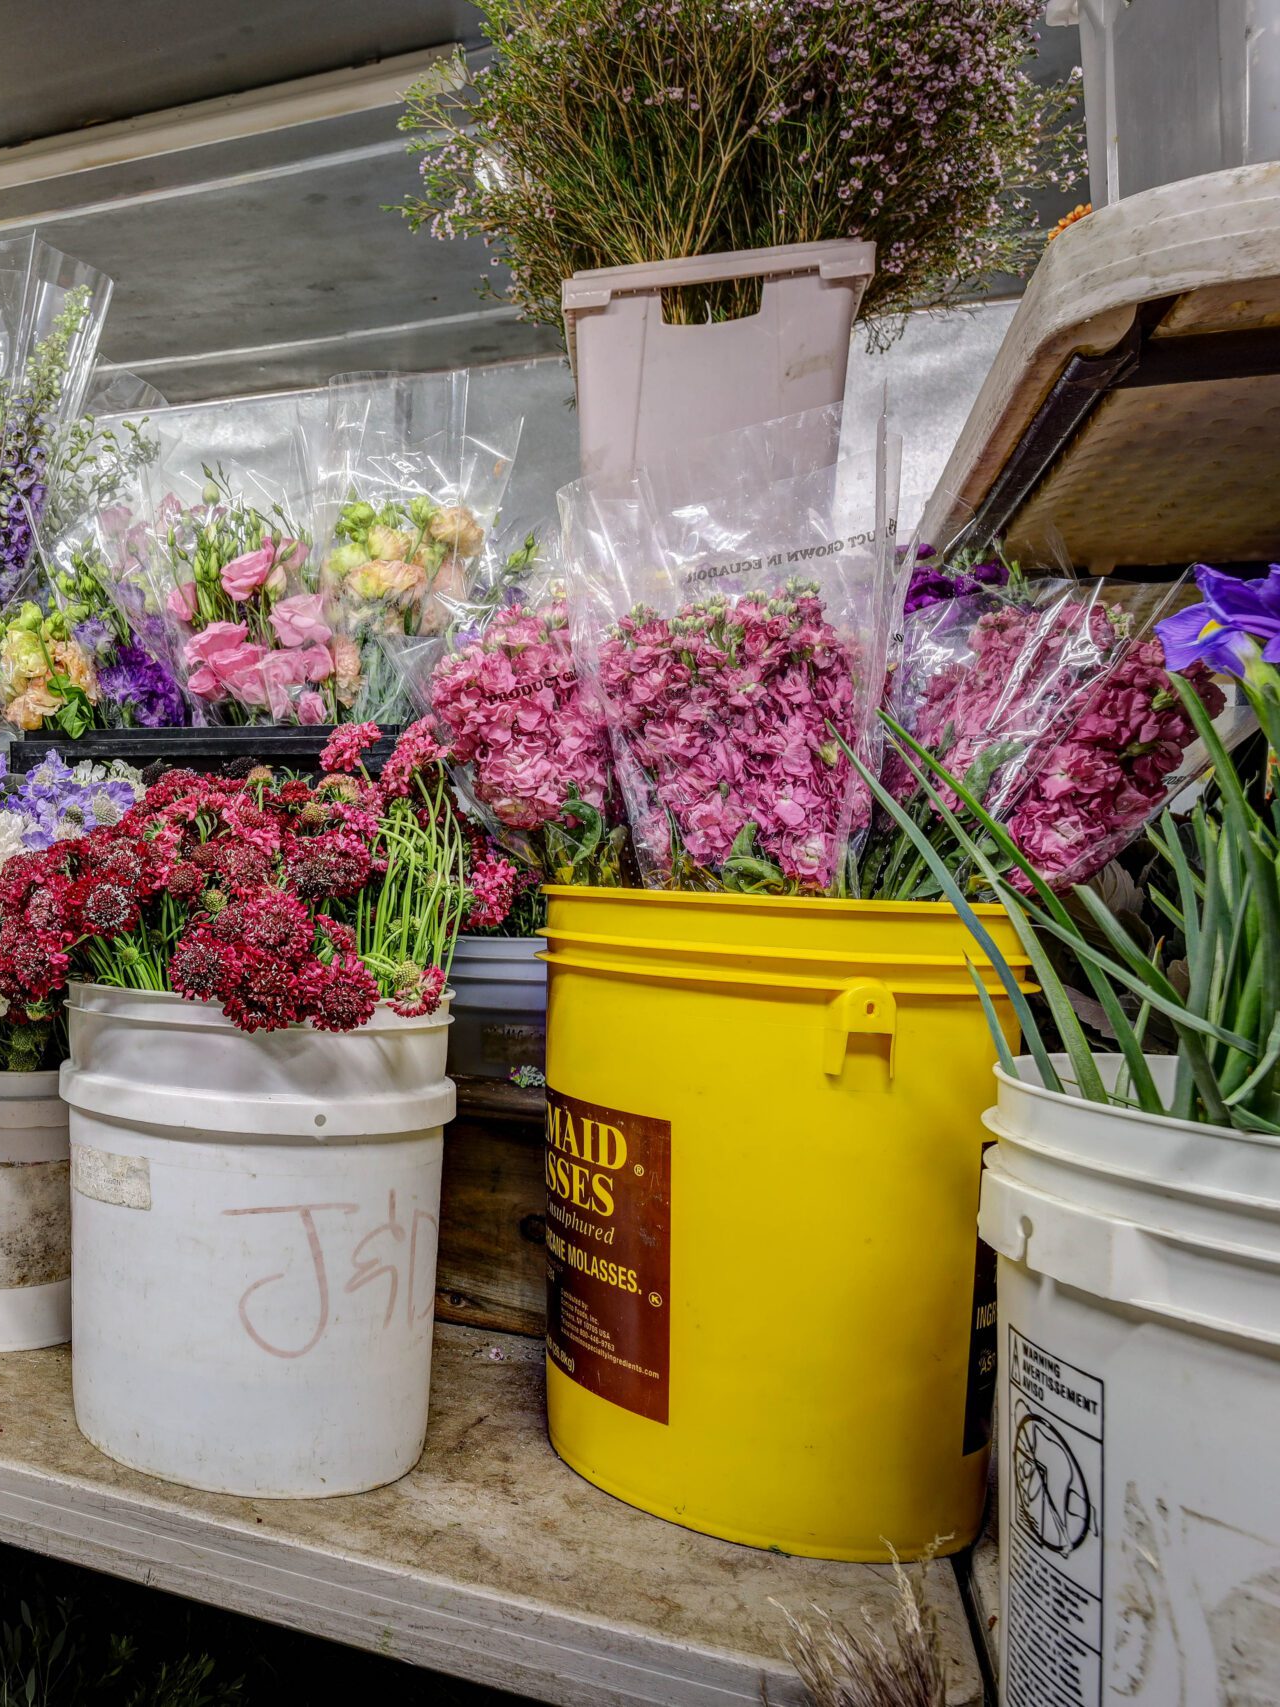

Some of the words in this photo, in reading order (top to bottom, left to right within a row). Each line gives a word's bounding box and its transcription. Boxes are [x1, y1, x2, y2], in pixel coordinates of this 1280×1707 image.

[487, 675, 561, 705] PRODUCT
[567, 1243, 643, 1295] MOLASSES.
[598, 1328, 611, 1340] USA
[1022, 1342, 1061, 1379] WARNING
[1022, 1358, 1098, 1416] AVERTISSEMENT
[1022, 1375, 1044, 1402] AVISO
